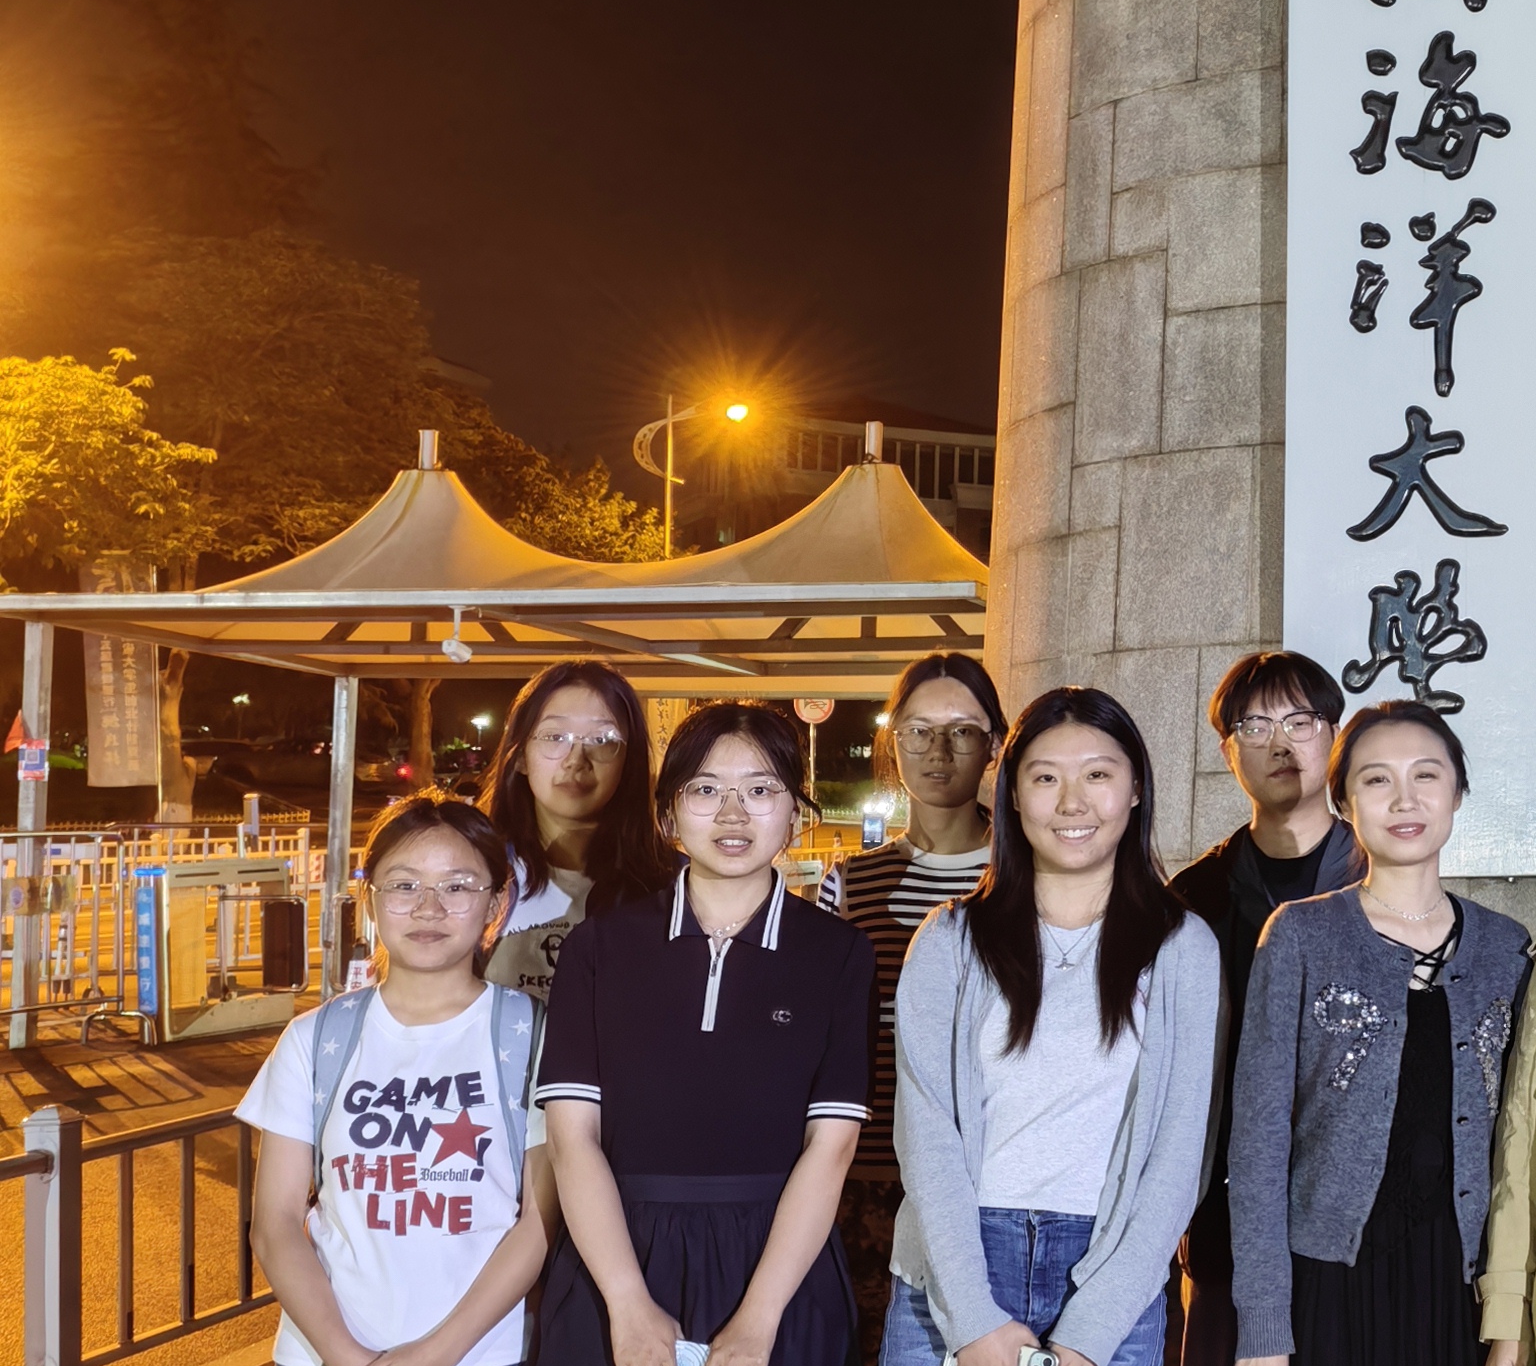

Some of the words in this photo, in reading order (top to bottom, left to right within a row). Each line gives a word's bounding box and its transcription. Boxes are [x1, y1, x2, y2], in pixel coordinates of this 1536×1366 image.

[343, 1071, 486, 1114] GAME
[349, 1112, 433, 1152] ON
[331, 1153, 418, 1192] THE
[418, 1167, 469, 1183] Baseball
[366, 1190, 473, 1236] LINE
